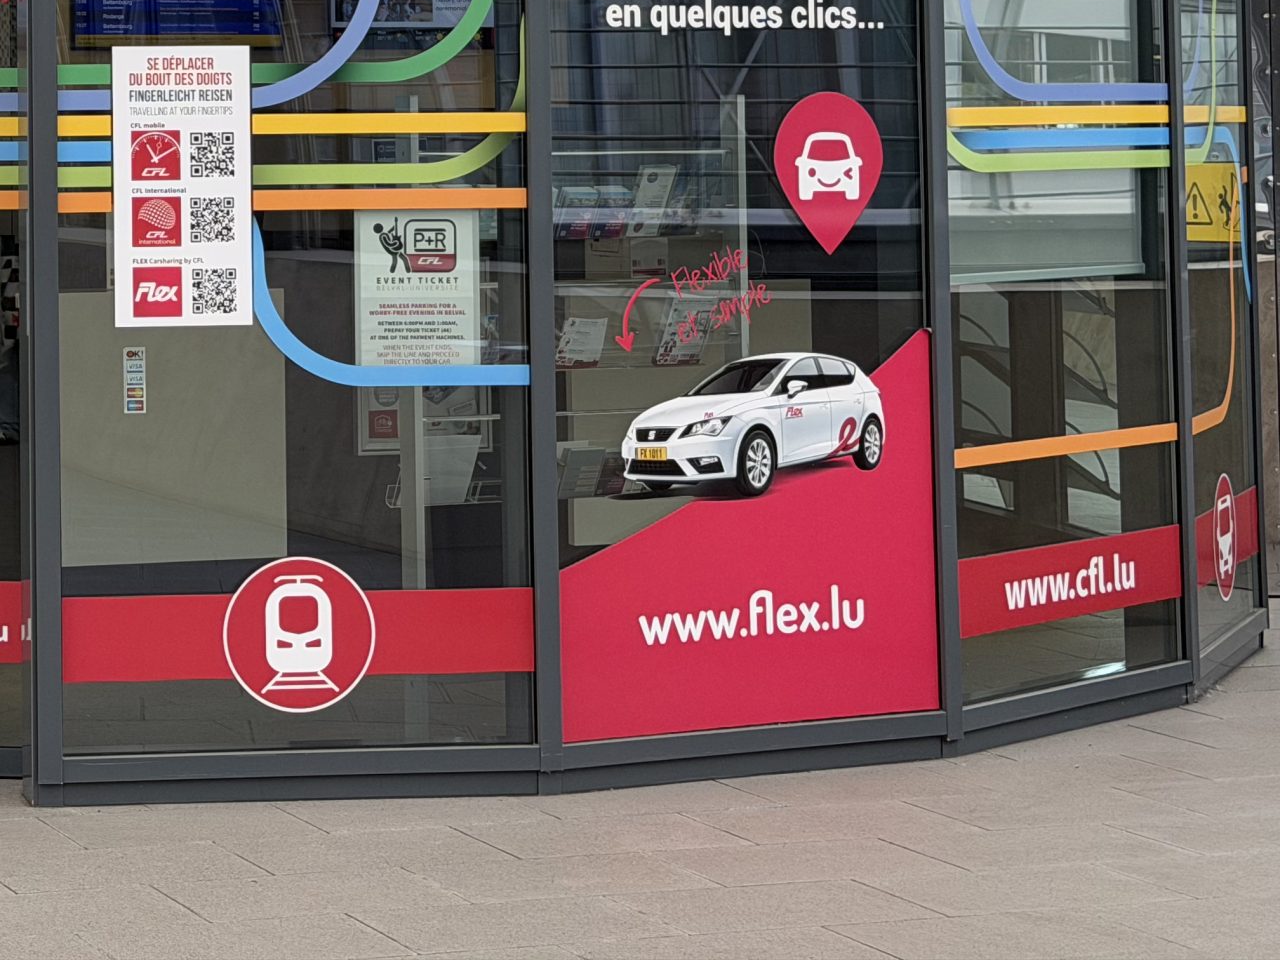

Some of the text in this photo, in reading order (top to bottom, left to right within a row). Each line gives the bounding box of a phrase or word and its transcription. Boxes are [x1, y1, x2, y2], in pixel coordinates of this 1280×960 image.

[605, 2, 641, 29] en
[147, 54, 214, 70] SE DÉPLACER
[129, 72, 233, 86] DU BOUT DES DOIGTS
[129, 89, 233, 102] FINGERLEICHT REISEN
[129, 106, 233, 116] TRAVELLING AT YOUR FINGERTIPS
[141, 167, 170, 177] CFL
[146, 231, 168, 239] CFL
[413, 232, 447, 249] P+R
[417, 256, 443, 265] CFL
[671, 245, 749, 298] Flexible
[376, 277, 459, 285] EVENT TICKET
[676, 281, 772, 343] et simple
[1004, 553, 1136, 610] www.cfl.lu
[638, 584, 865, 646] www.flex.lu
